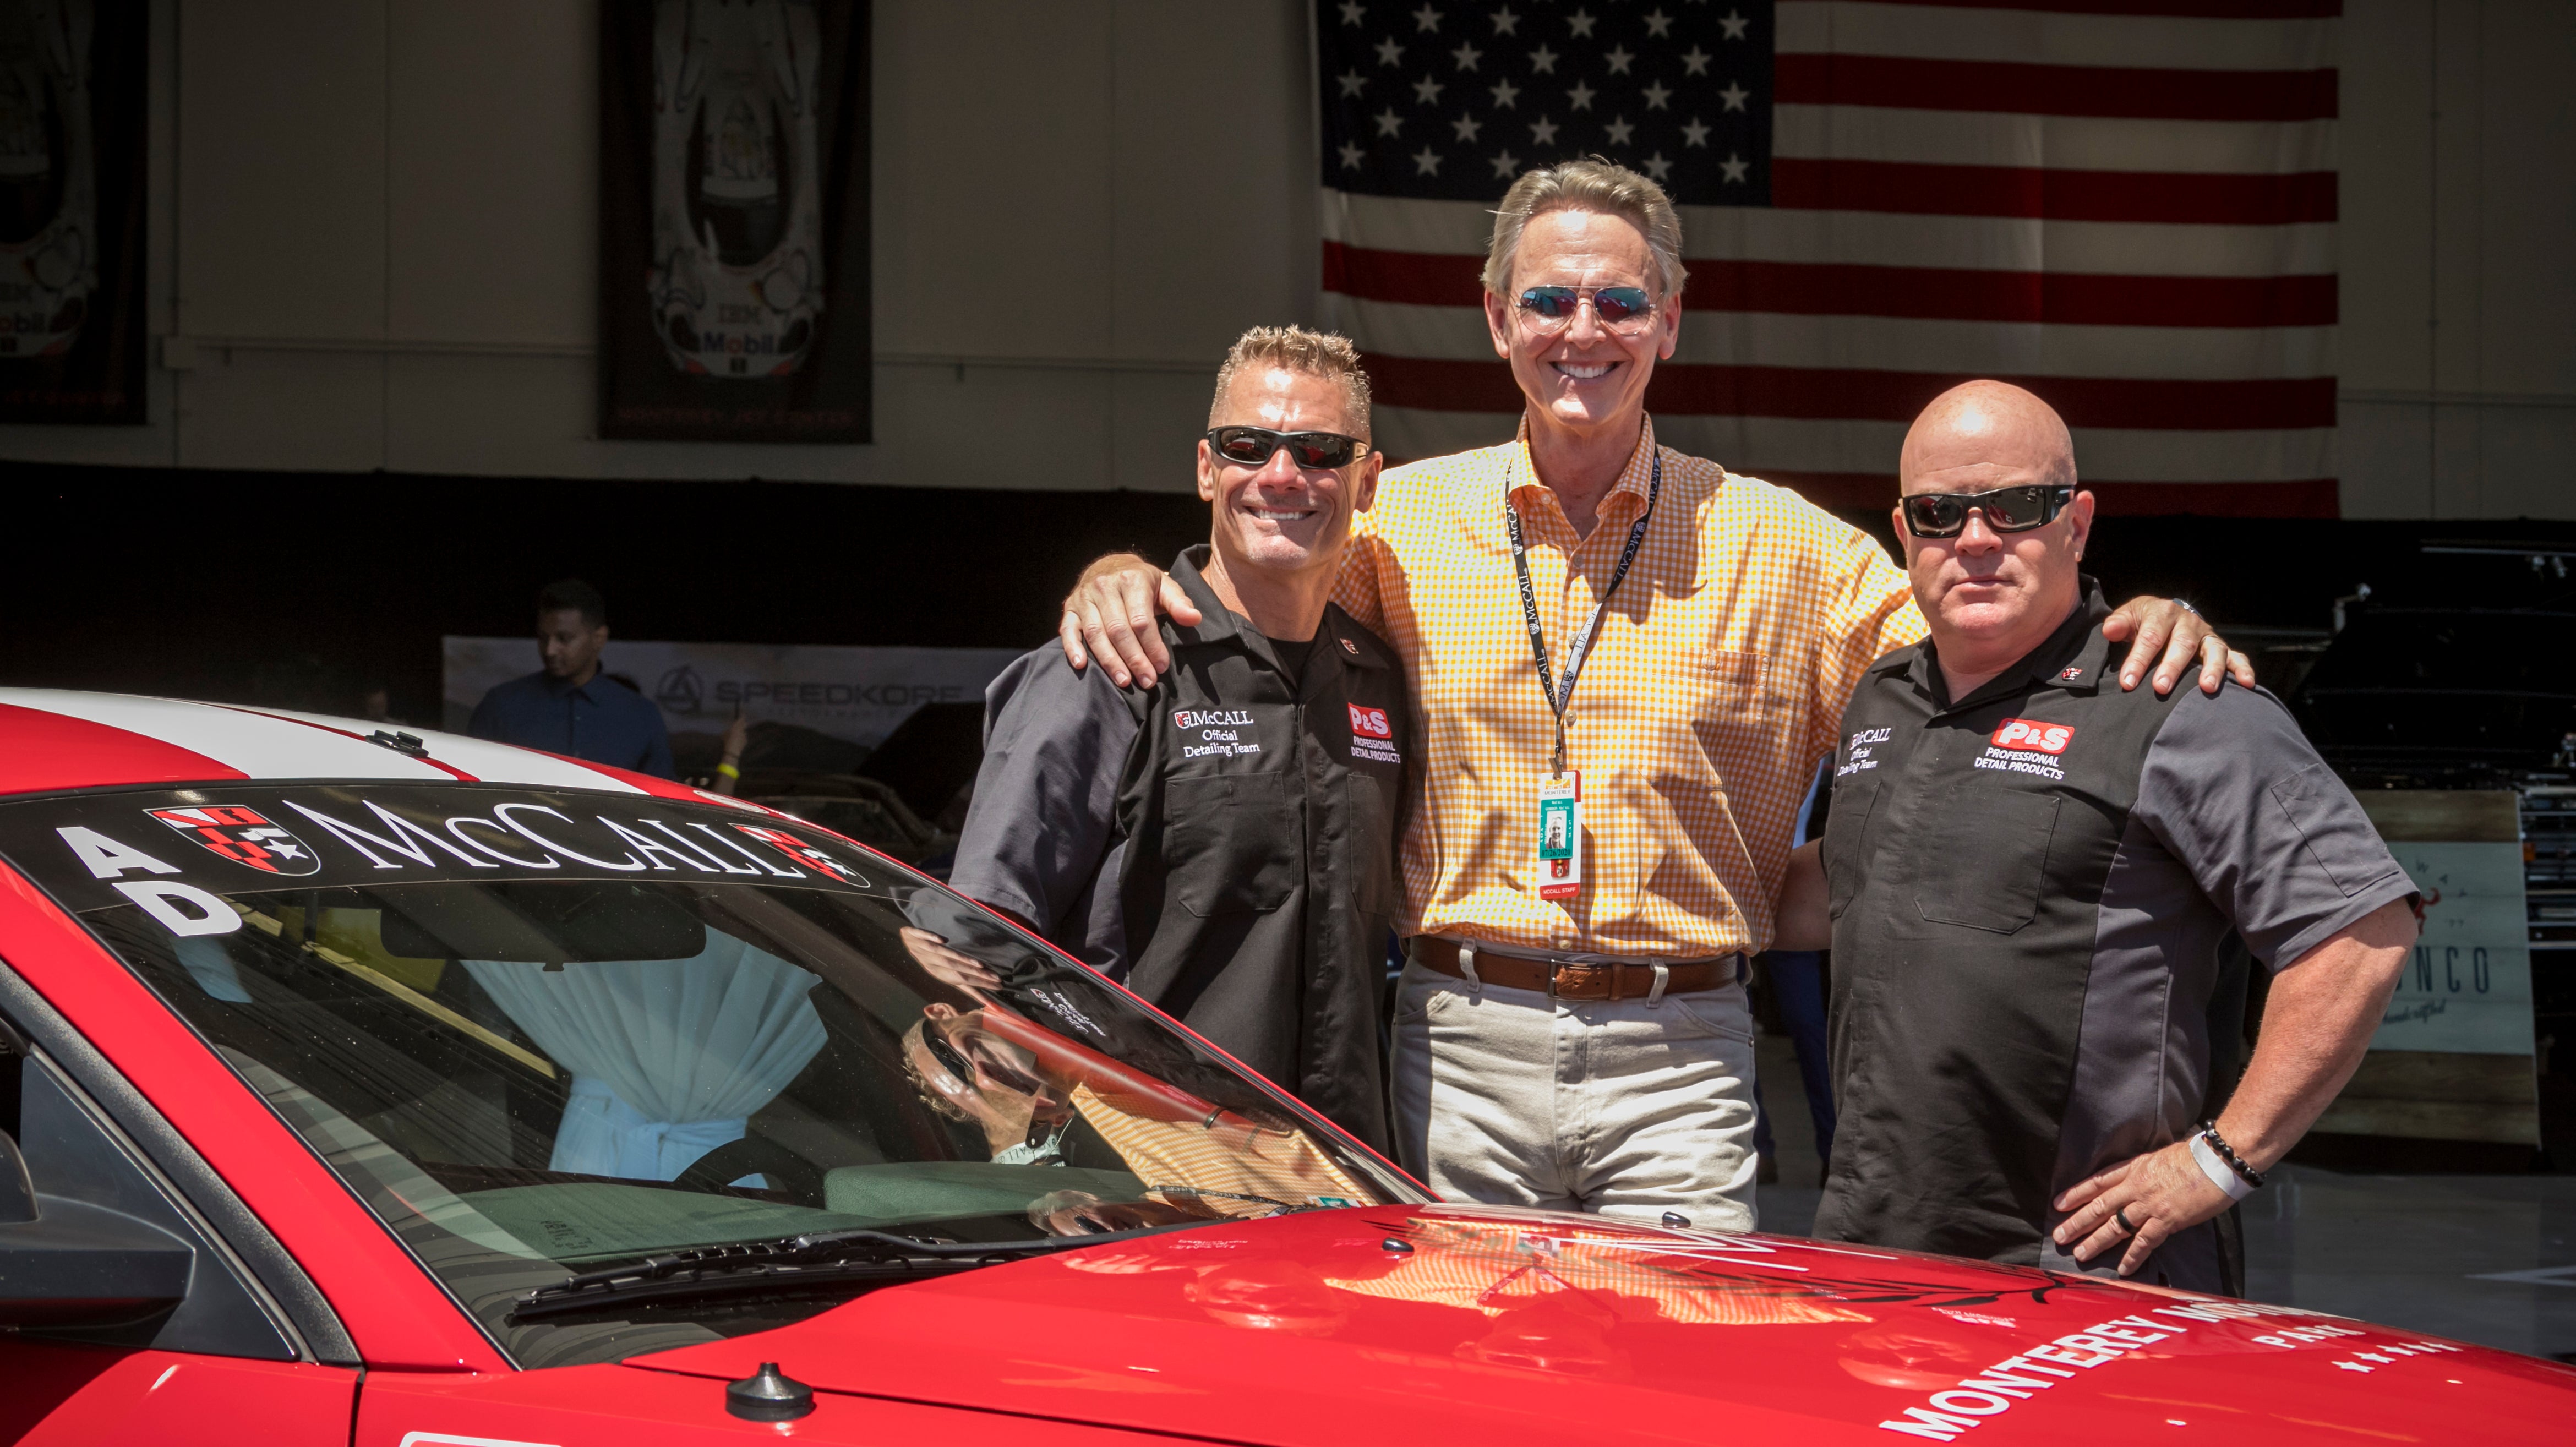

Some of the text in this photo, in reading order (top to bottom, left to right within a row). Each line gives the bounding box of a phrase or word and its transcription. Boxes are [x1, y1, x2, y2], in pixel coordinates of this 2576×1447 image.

[703, 331, 774, 354] Mobil
[1617, 532, 1642, 577] McCALL
[1520, 571, 1537, 620] McCALL
[1192, 710, 1253, 726] McCALL
[1350, 706, 1388, 735] P&S
[1202, 729, 1238, 741] Official
[1354, 736, 1395, 751] PROFESSIONAL
[1998, 722, 2069, 751] P&S
[1183, 742, 1260, 757] Detailing Team
[1351, 746, 1400, 764] DETAIL PRODUCTS
[1985, 747, 2060, 767] PROFESSIONAL
[1859, 759, 1878, 769] Team
[1974, 757, 2065, 780] DETAIL PRODUCTS
[282, 799, 807, 878] McCALL
[56, 826, 182, 878] A
[1541, 848, 1571, 857] 07/26/2020
[112, 881, 242, 937] D
[2396, 945, 2489, 993] NCO
[2251, 1325, 2366, 1349] PARK
[1878, 1315, 2187, 1442] MONTEREY
